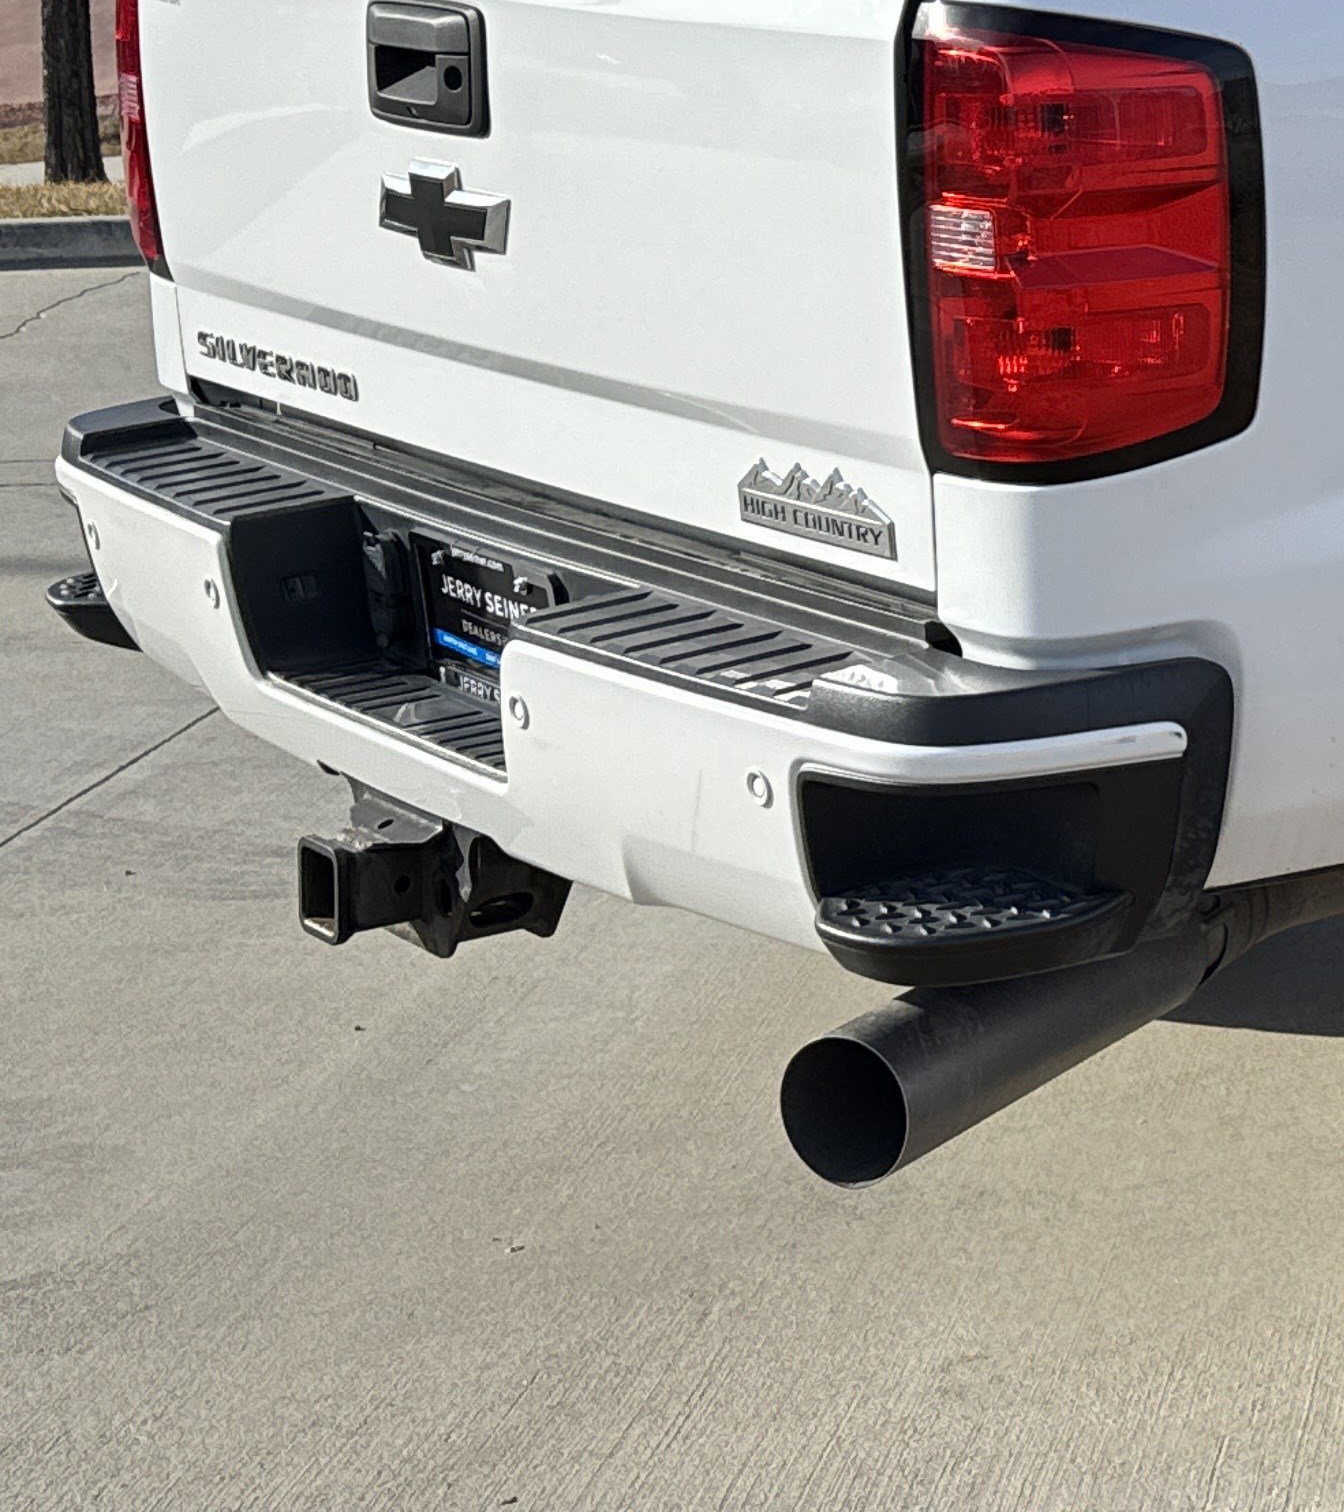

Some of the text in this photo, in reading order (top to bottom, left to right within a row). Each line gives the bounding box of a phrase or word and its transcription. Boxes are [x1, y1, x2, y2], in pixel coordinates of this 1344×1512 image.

[197, 330, 359, 403] SILVERADO
[743, 495, 883, 546] HIGH COUNTRY
[441, 573, 482, 608] JERRY
